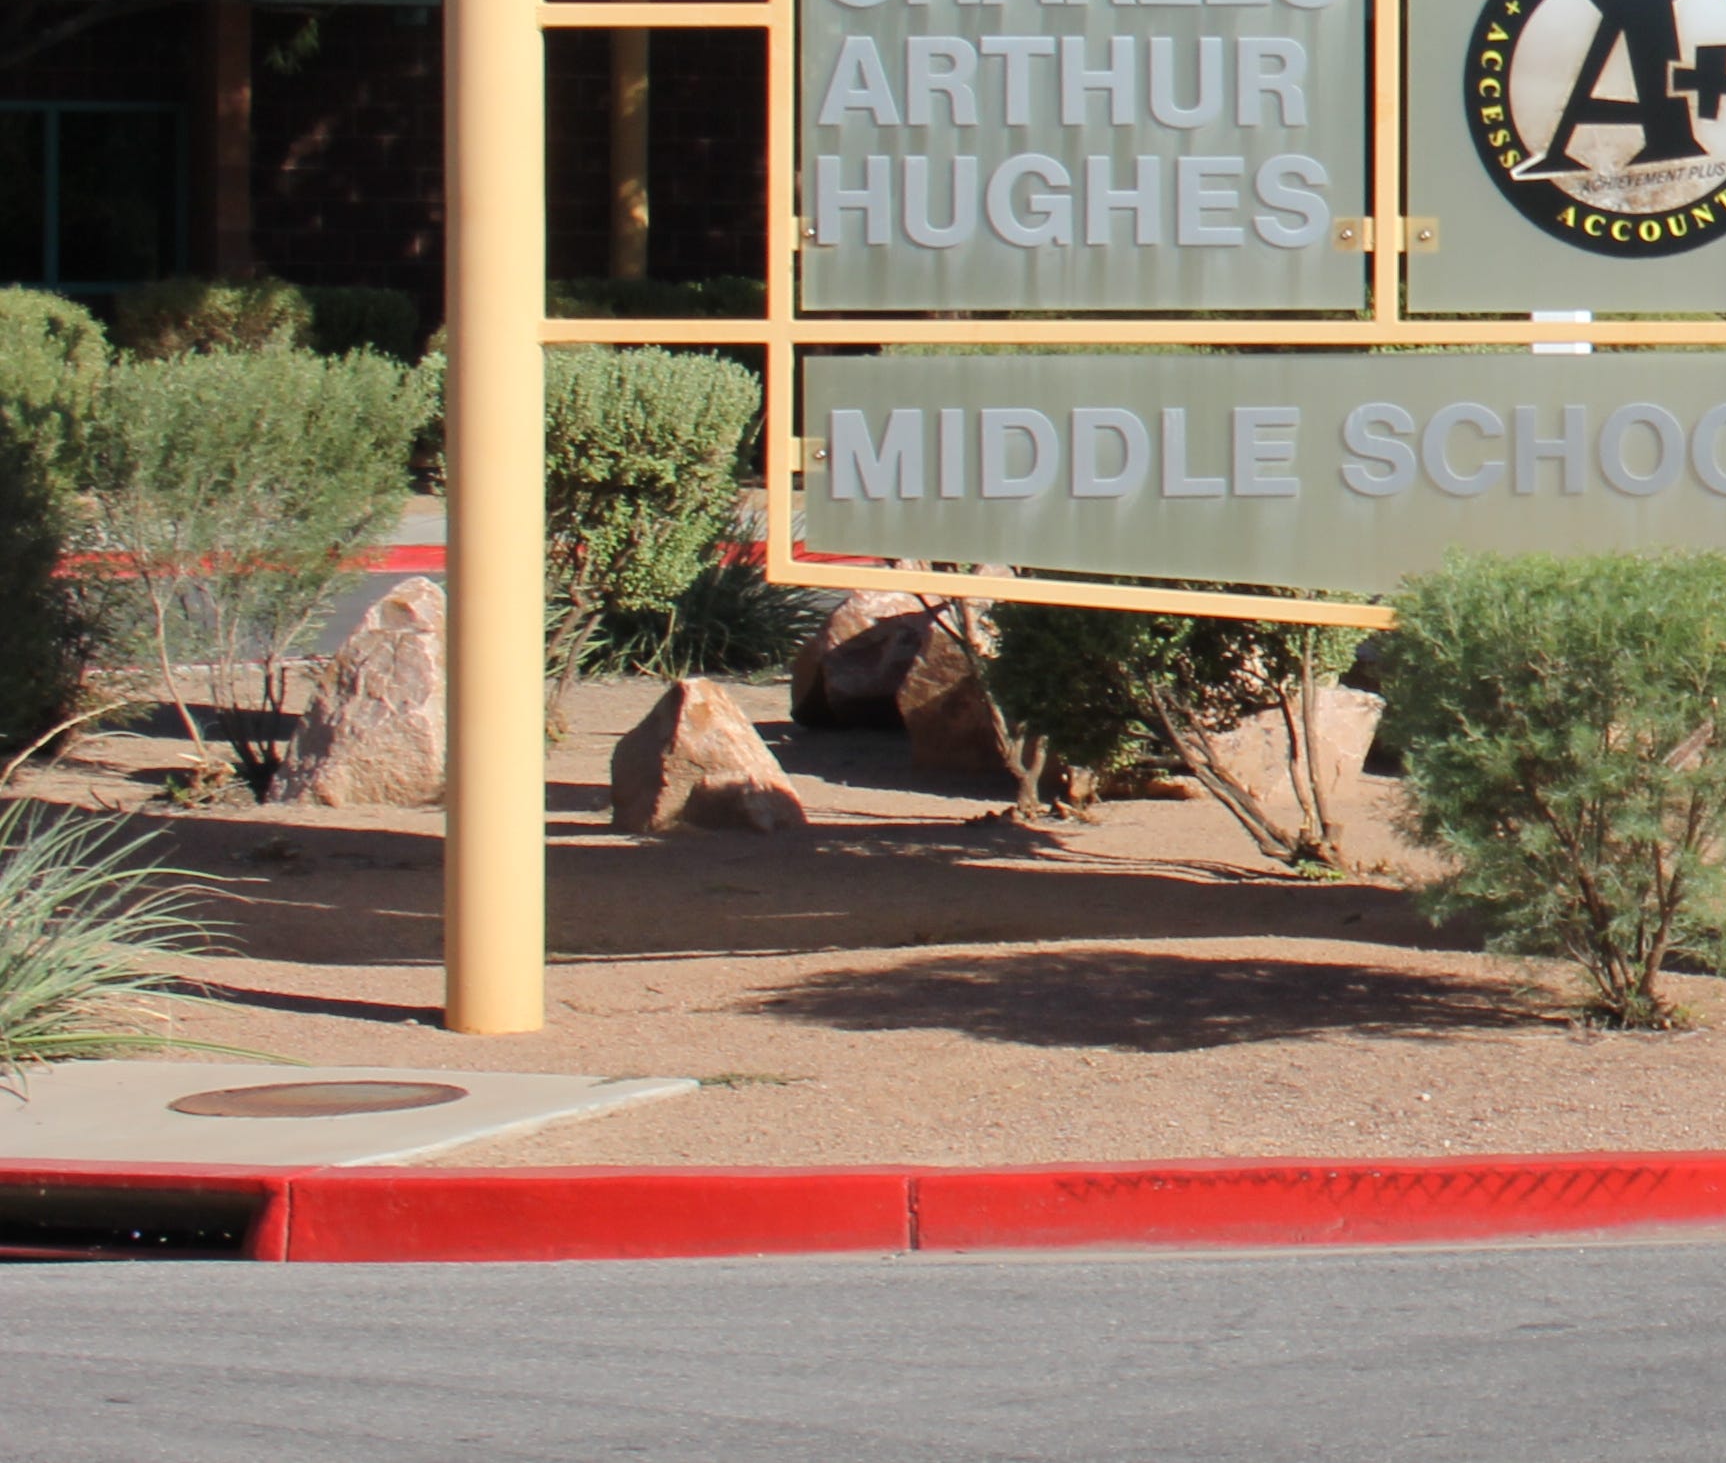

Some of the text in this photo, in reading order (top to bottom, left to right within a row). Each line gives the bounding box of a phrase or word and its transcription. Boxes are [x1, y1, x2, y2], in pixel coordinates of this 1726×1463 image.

[817, 35, 1308, 130] ARTHUR
[1478, 22, 1522, 170] ACCESS
[815, 152, 1332, 249] HUGHES
[1580, 161, 1726, 195] ACHIEVEMENT PLUS
[830, 406, 1300, 501] MIDDLE
